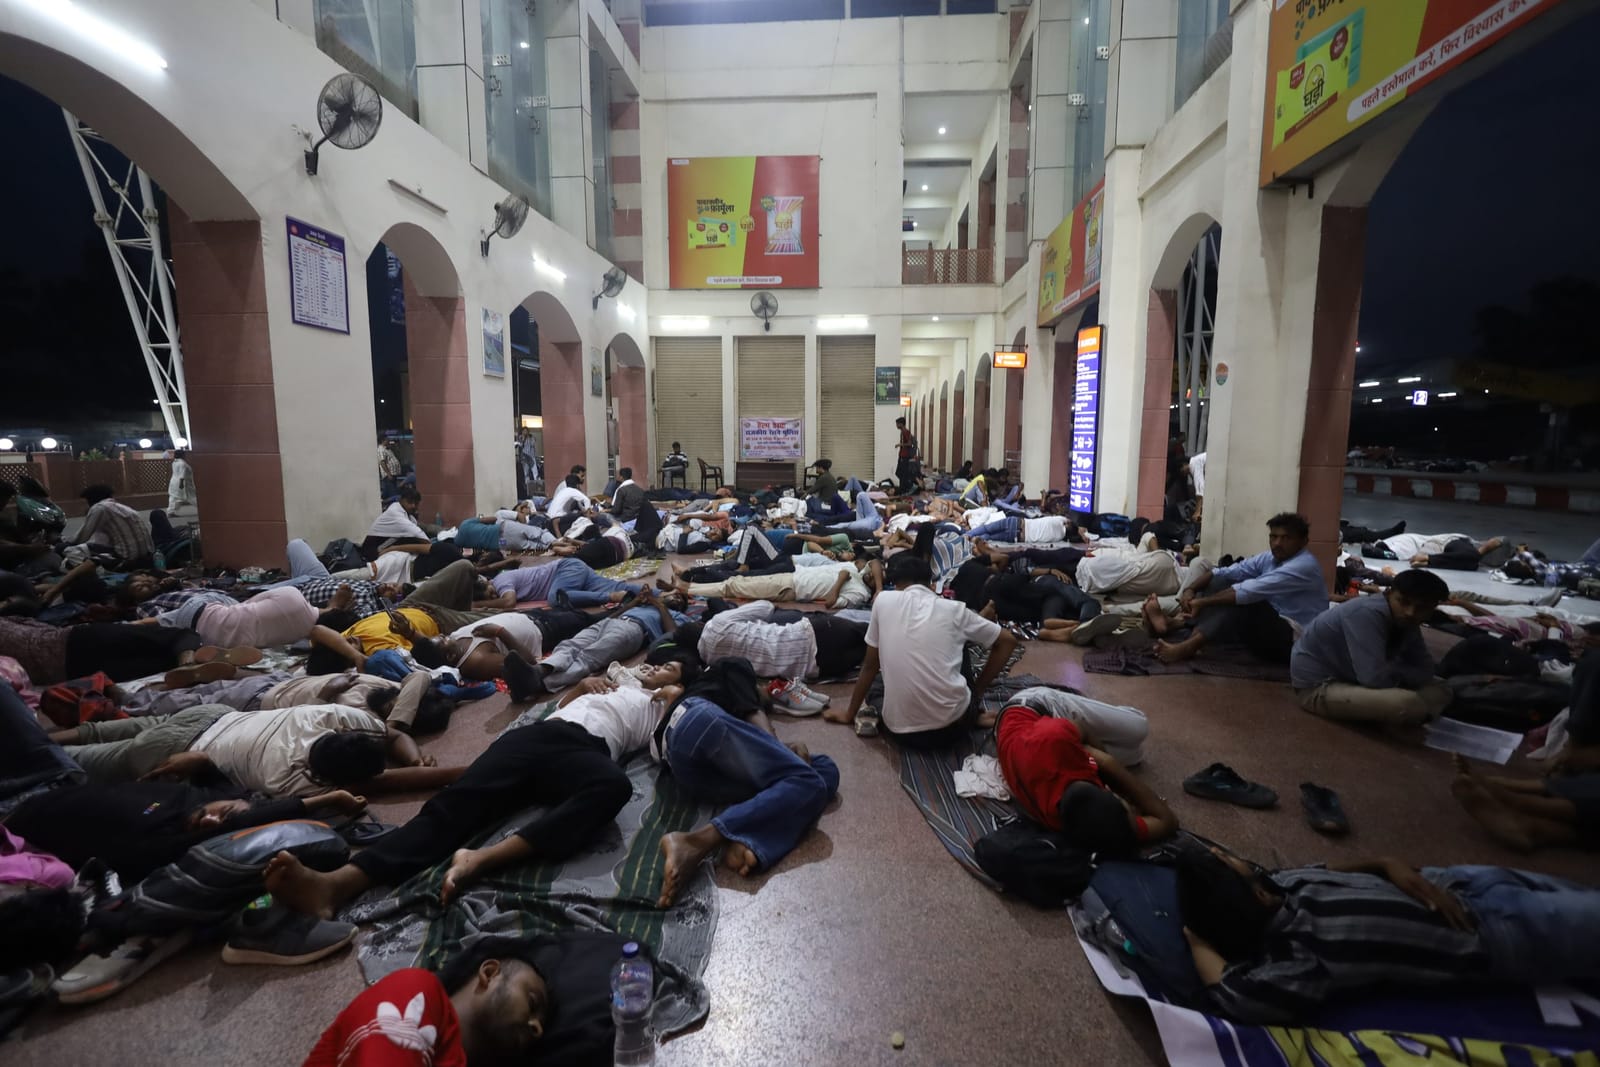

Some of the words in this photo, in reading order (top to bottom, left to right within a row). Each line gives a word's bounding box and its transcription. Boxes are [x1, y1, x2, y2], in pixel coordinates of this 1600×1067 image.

[1361, 87, 1381, 109] पहले
[1382, 65, 1416, 97] इस्तेमाल
[1440, 36, 1460, 59] फिर
[1463, 6, 1505, 44] विश्वास
